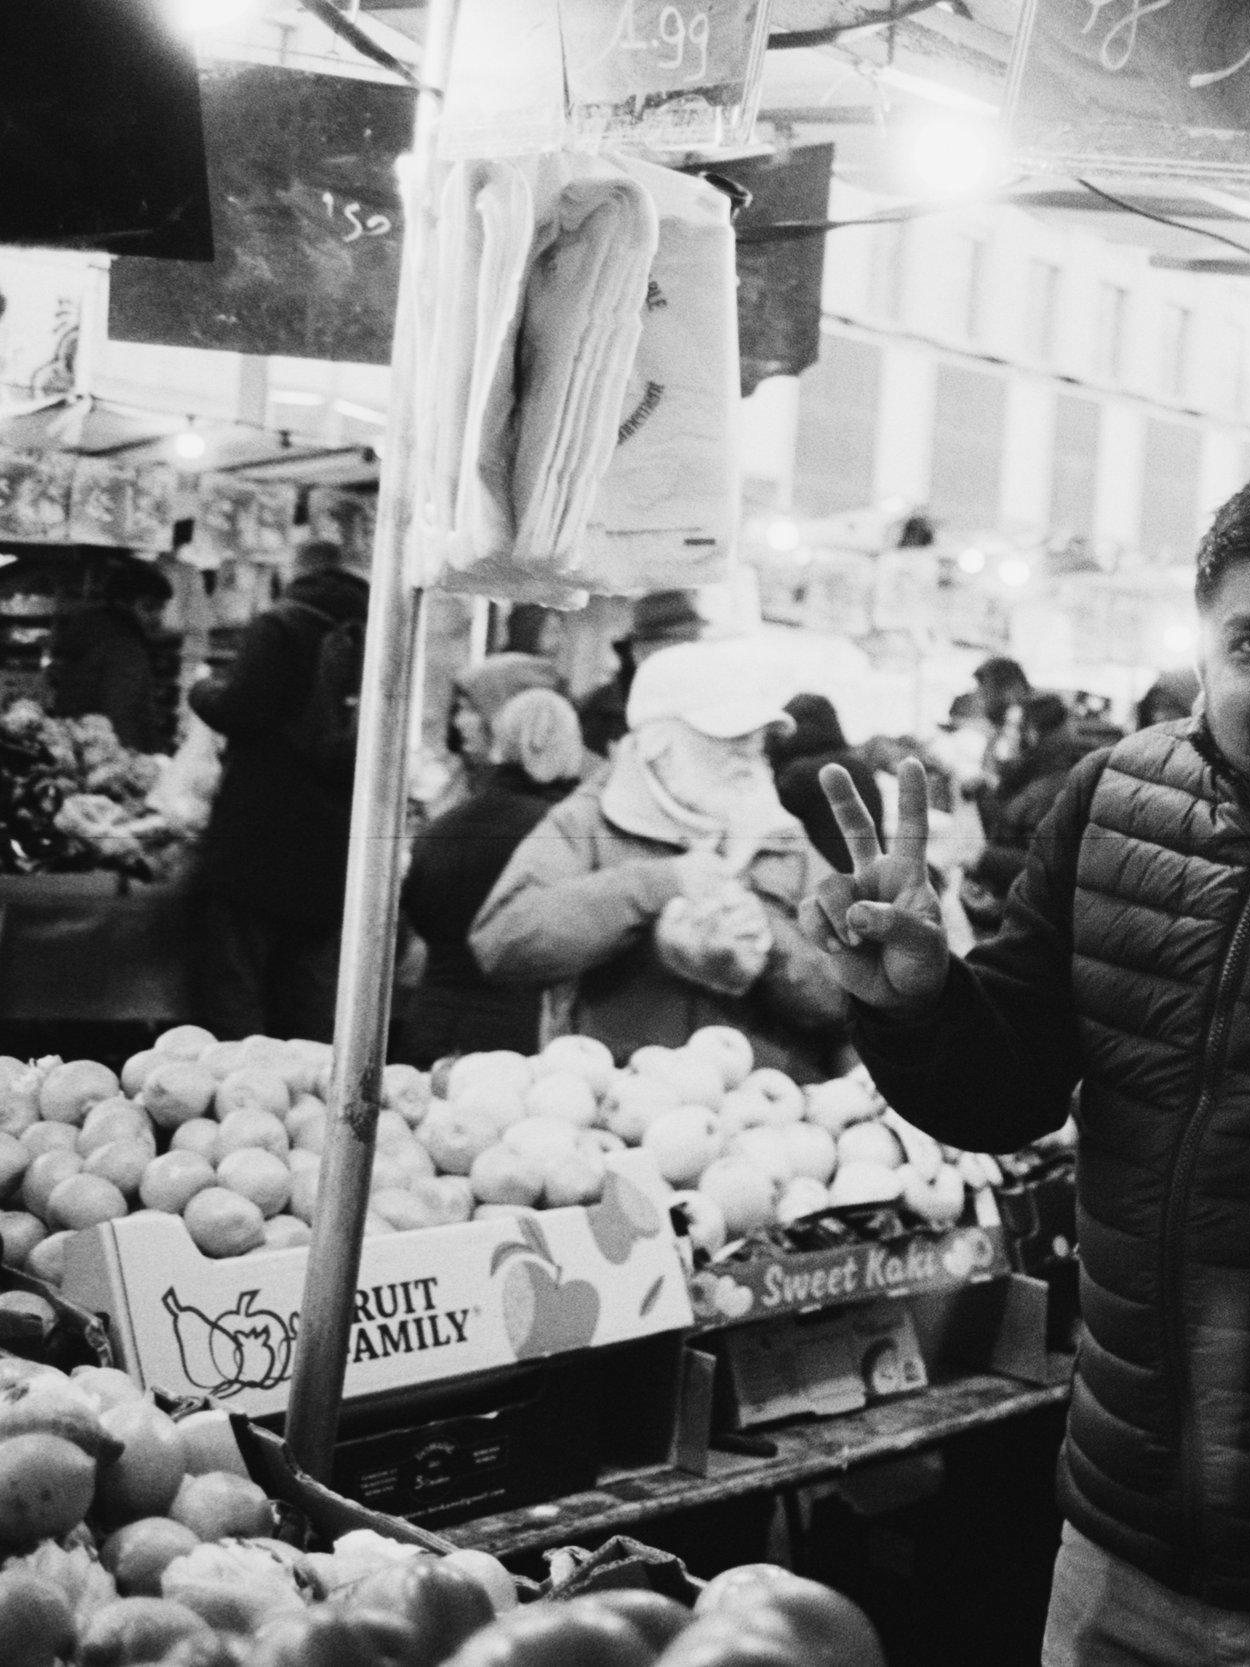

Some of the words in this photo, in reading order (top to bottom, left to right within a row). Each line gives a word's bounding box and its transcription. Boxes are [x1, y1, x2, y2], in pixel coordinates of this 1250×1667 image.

[598, 0, 710, 83] 1.99
[353, 1275, 438, 1324] RUIT
[761, 1256, 859, 1307] Sweet
[349, 1308, 470, 1363] AMILY
